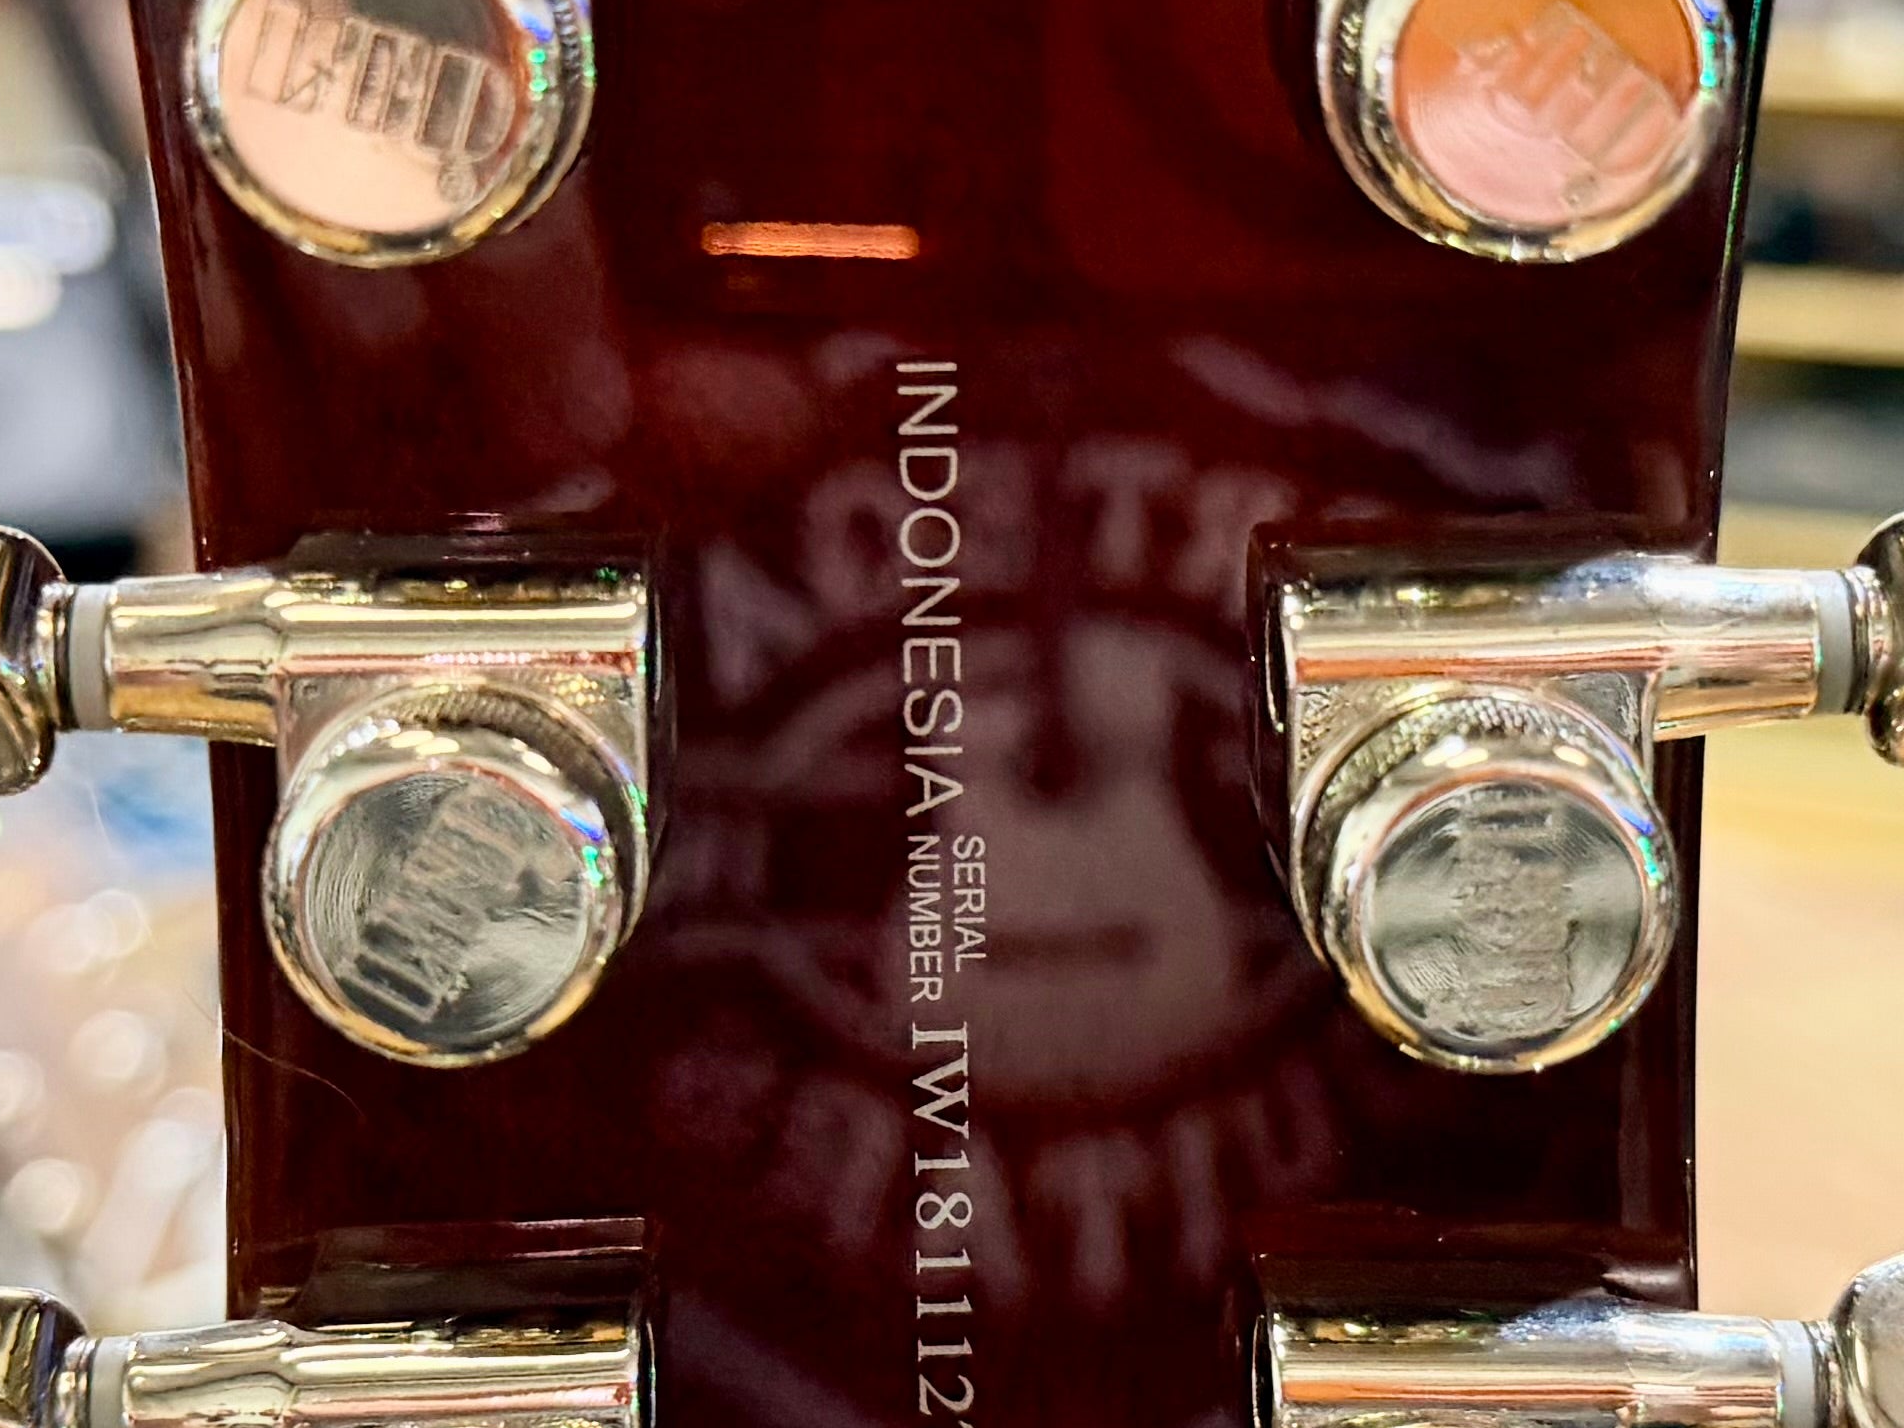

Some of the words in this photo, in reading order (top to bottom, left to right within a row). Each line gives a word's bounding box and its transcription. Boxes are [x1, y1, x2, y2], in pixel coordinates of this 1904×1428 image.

[896, 361, 964, 817] INDONESIA
[907, 834, 944, 1004] NUMBER
[952, 834, 987, 972] SERIAL
